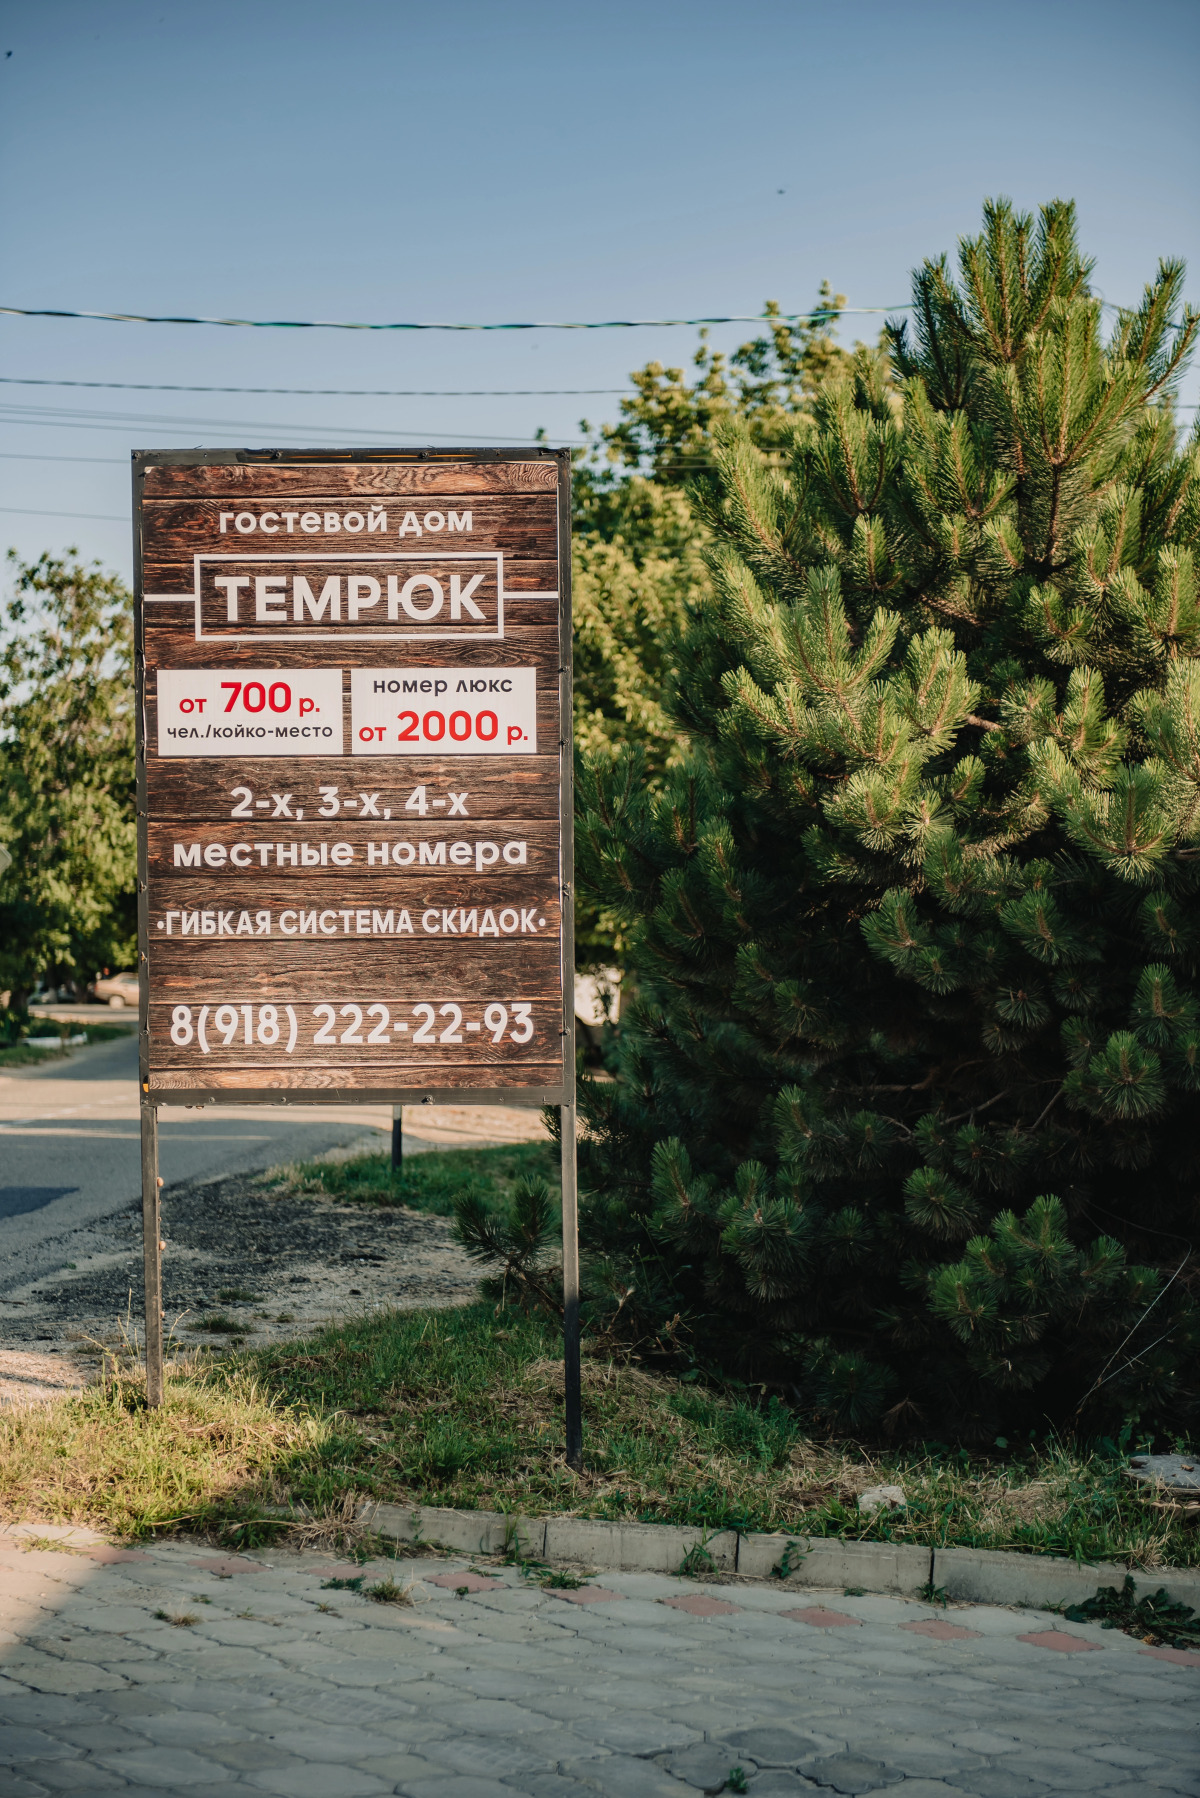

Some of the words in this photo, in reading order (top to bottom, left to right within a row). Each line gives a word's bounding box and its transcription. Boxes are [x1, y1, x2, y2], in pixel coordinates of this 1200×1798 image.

[219, 505, 387, 534] гостевой
[399, 510, 473, 537] дом
[214, 574, 487, 622] ТЕМРЮК
[179, 697, 207, 714] от
[220, 681, 292, 713] 700
[299, 696, 321, 717] р.
[373, 677, 448, 697] номер
[456, 677, 513, 693] люкс
[167, 722, 333, 740] чел./койко-место
[359, 726, 387, 741] от
[397, 710, 499, 742] 2000
[507, 725, 529, 745] р.
[230, 786, 304, 821] 2-х,
[317, 786, 392, 820] 3-х,
[405, 786, 469, 815] 4-х
[173, 842, 353, 867] местные
[367, 841, 527, 871] номера
[279, 909, 414, 934] СИСТЕМА
[170, 1004, 299, 1054] 8(918)
[313, 1003, 534, 1045] 222-22-93
